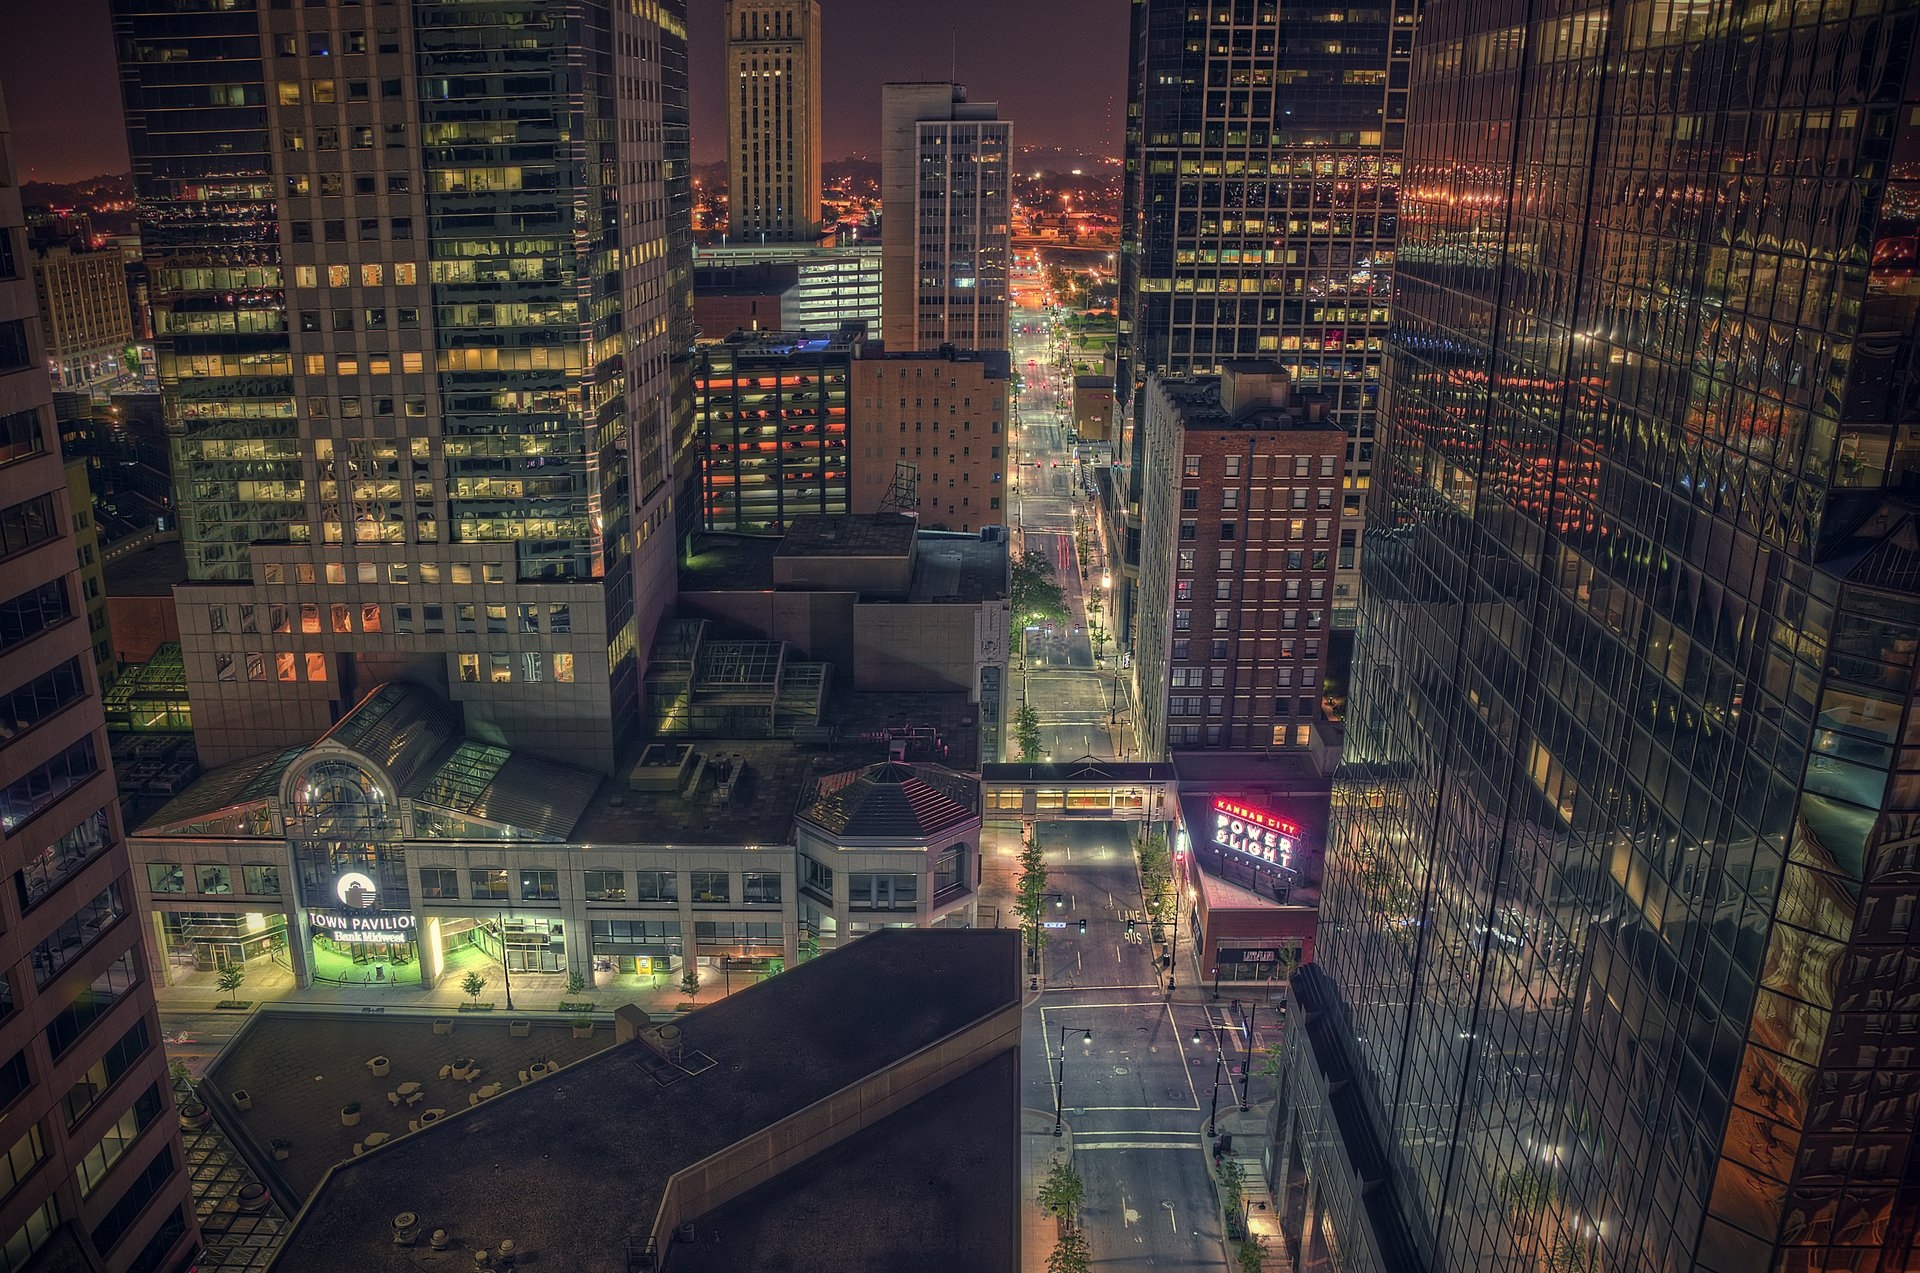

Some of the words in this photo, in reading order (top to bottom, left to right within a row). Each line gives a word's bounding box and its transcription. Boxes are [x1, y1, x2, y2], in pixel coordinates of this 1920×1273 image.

[1217, 800, 1264, 823] KANSAS
[1268, 818, 1295, 834] CITY
[1217, 814, 1294, 853] POWER
[310, 913, 346, 929] TOWN
[1117, 910, 1142, 922] LANE
[334, 932, 362, 942] Bank
[362, 931, 405, 942] Midwest
[1124, 932, 1143, 945] BUS
